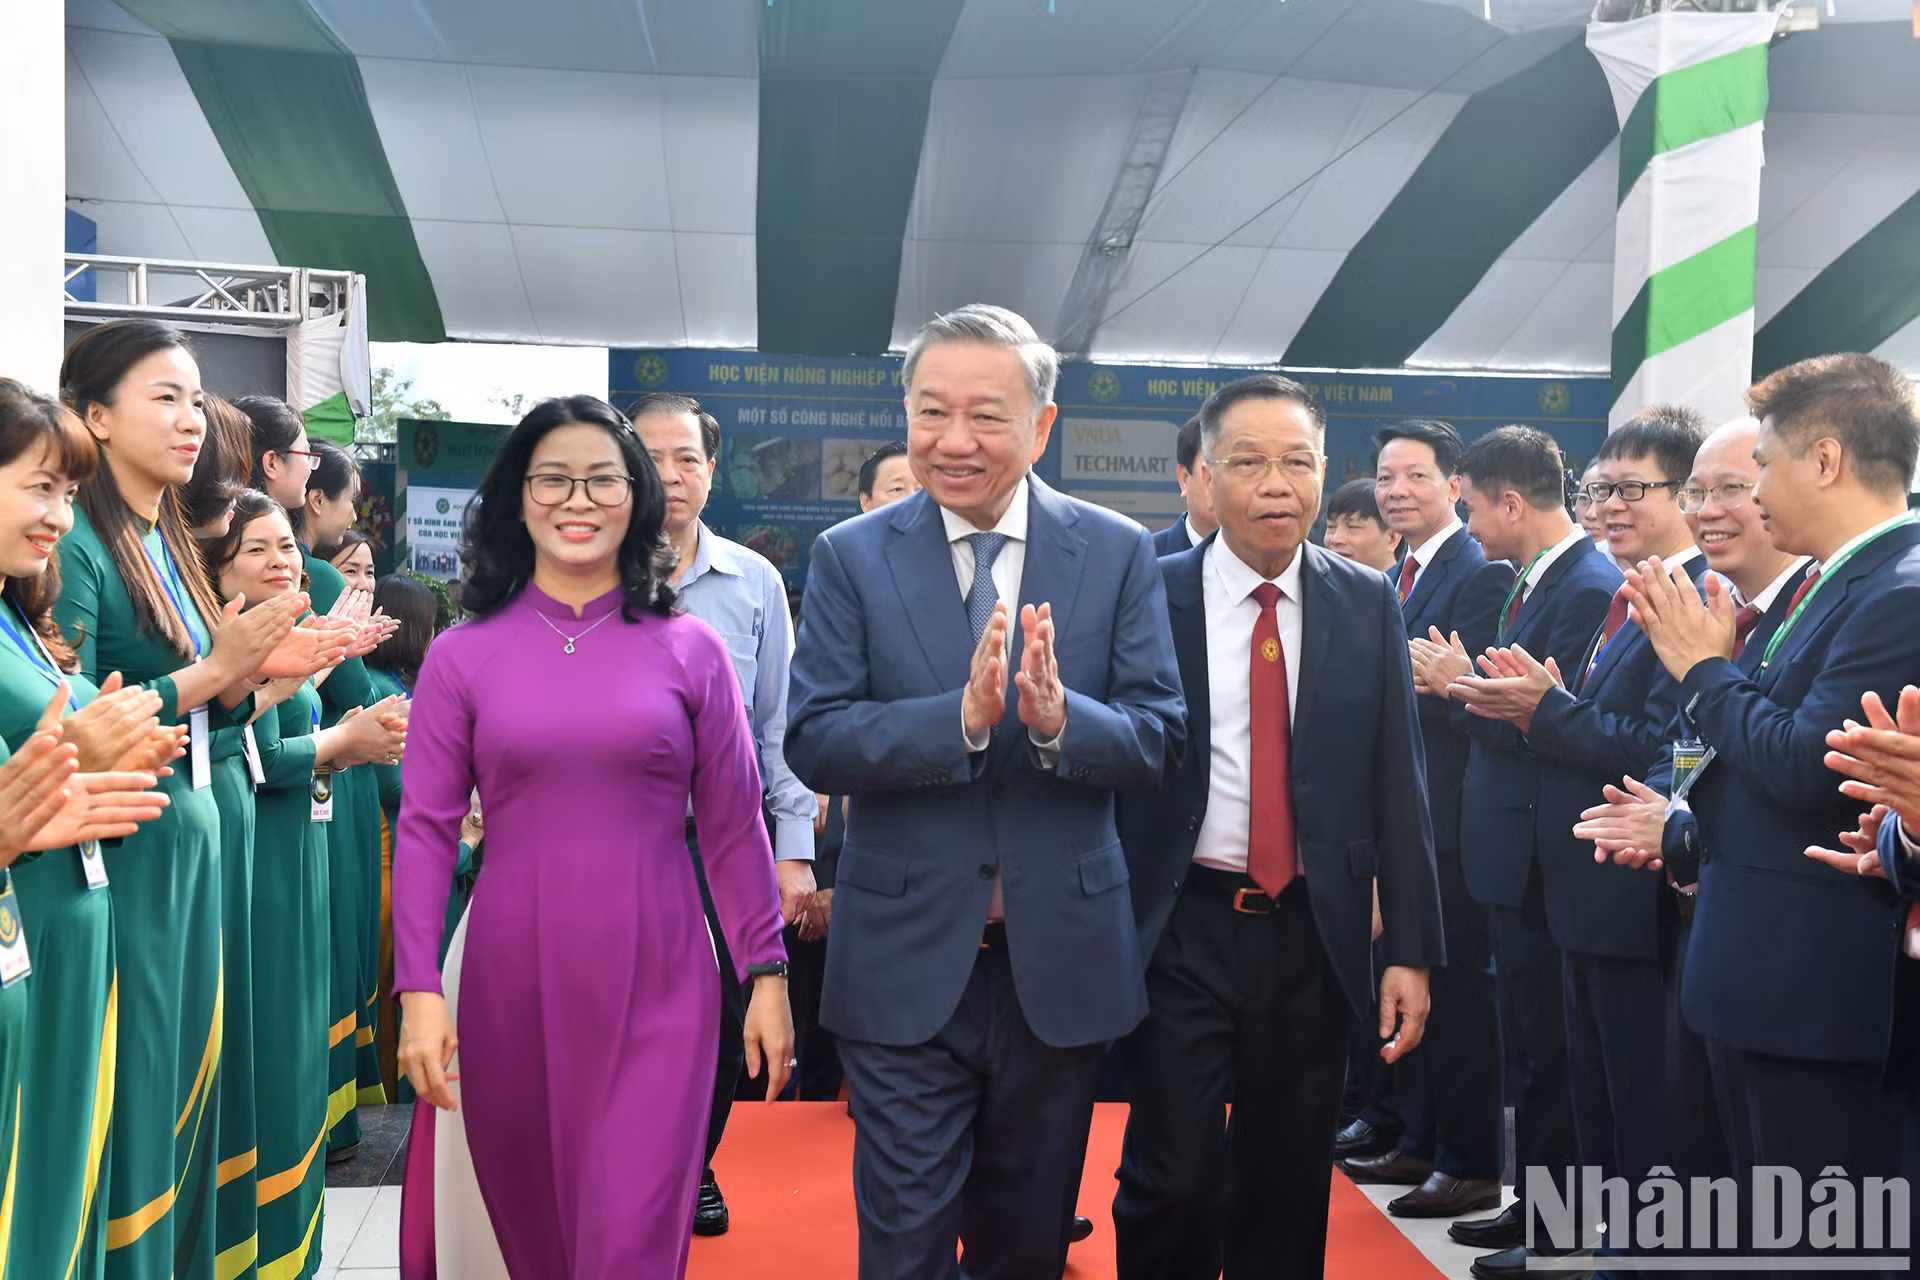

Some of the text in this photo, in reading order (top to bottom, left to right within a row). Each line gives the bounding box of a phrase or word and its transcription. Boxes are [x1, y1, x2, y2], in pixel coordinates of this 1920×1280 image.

[709, 364, 740, 385] HỌC
[744, 363, 779, 386] VIỆN
[783, 364, 826, 384] NÔNG
[831, 367, 886, 389] NGHIỆP
[1148, 378, 1177, 400] HỌC
[1182, 377, 1216, 400] VIỆN
[1324, 381, 1355, 404] VIỆT
[1358, 386, 1393, 403] NAM
[738, 408, 767, 427] MỘT
[770, 404, 788, 424] SỐ
[791, 407, 827, 426] CÔNG
[831, 409, 866, 430] NGHỆ
[1074, 426, 1123, 445] VNUA
[1073, 453, 1170, 474] TECHMART
[434, 530, 448, 540] HỌC
